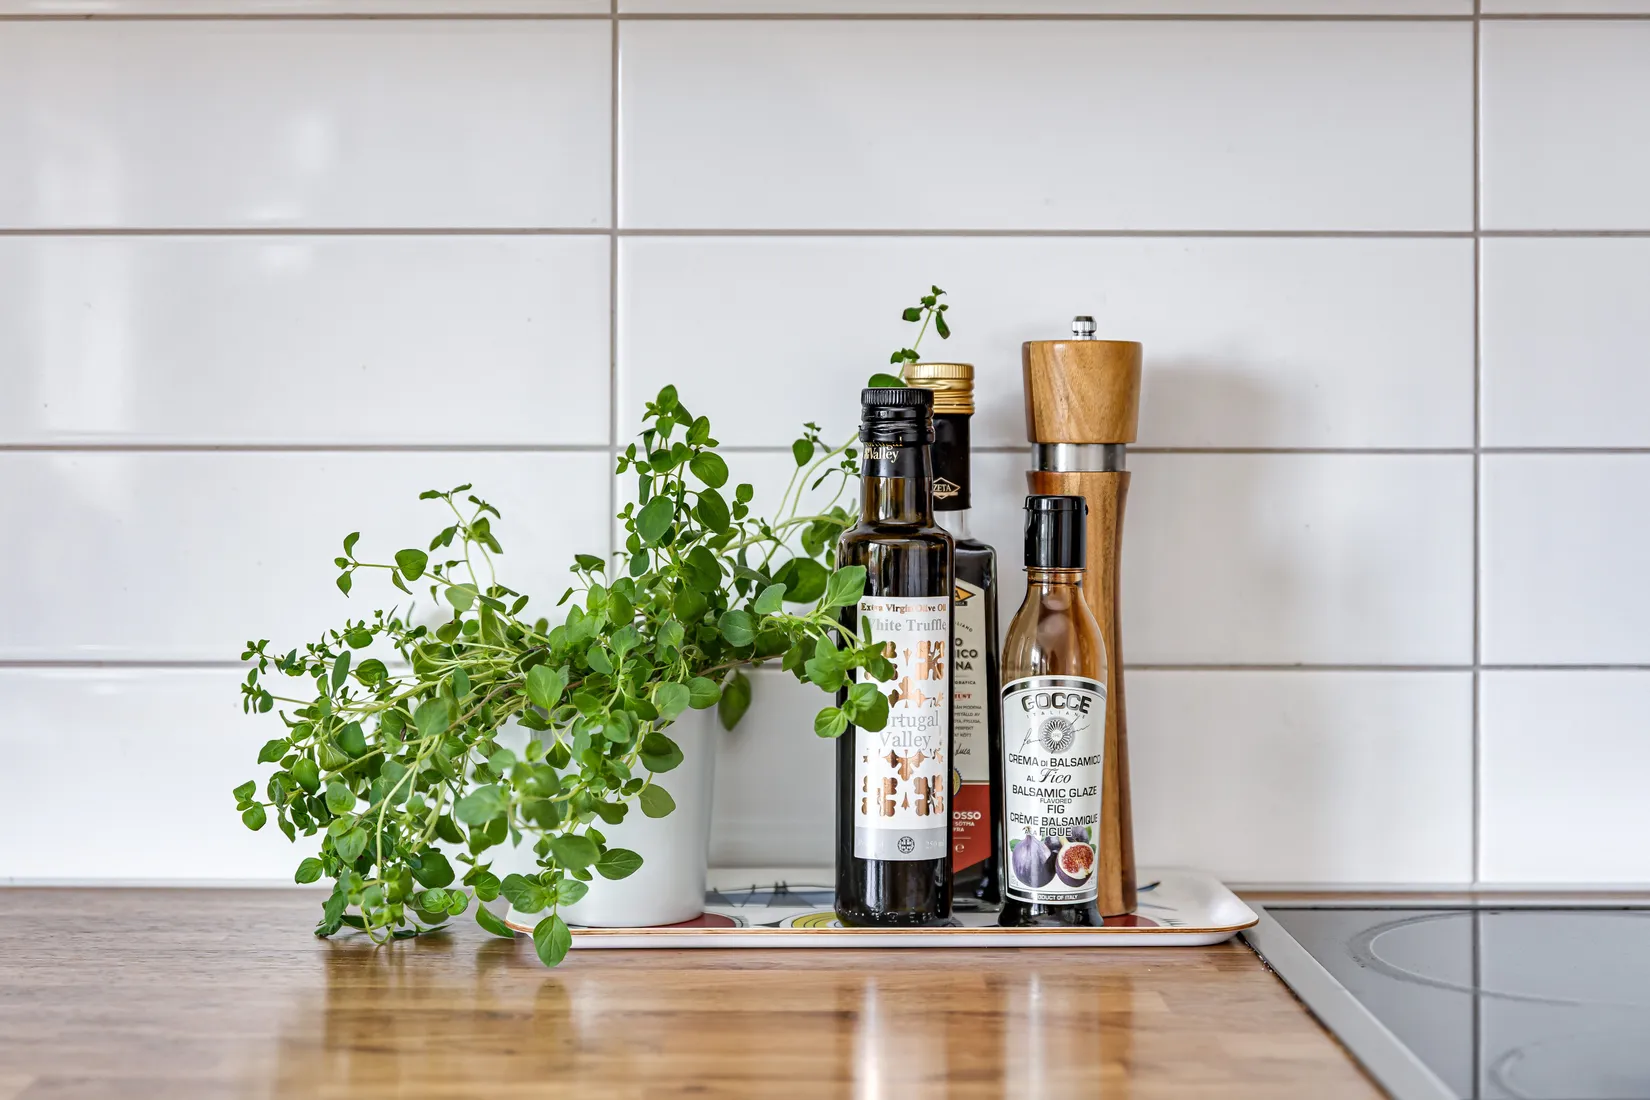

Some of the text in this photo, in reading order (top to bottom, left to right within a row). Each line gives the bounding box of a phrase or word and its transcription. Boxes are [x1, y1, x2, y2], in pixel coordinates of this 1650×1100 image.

[868, 447, 899, 464] Valley
[933, 484, 952, 492] ZETA
[861, 602, 883, 611] Extra
[886, 604, 913, 614] Virgin
[871, 618, 947, 632] hite Truffle
[956, 649, 979, 659] ICO
[955, 661, 974, 671] NA
[1021, 692, 1092, 714] GOCCE
[887, 709, 939, 732] rtugal
[880, 730, 931, 750] Valley
[1008, 753, 1039, 767] CREMA
[1050, 754, 1101, 767] BALSAMICO
[1039, 768, 1072, 783] Fico
[1012, 784, 1097, 798] BALSAMIC GLAZE
[953, 811, 982, 820] OSSO
[1047, 804, 1065, 814] FIG
[1010, 812, 1098, 827] CRÈME BALSAMIQUE
[1039, 827, 1072, 837] FIGUE
